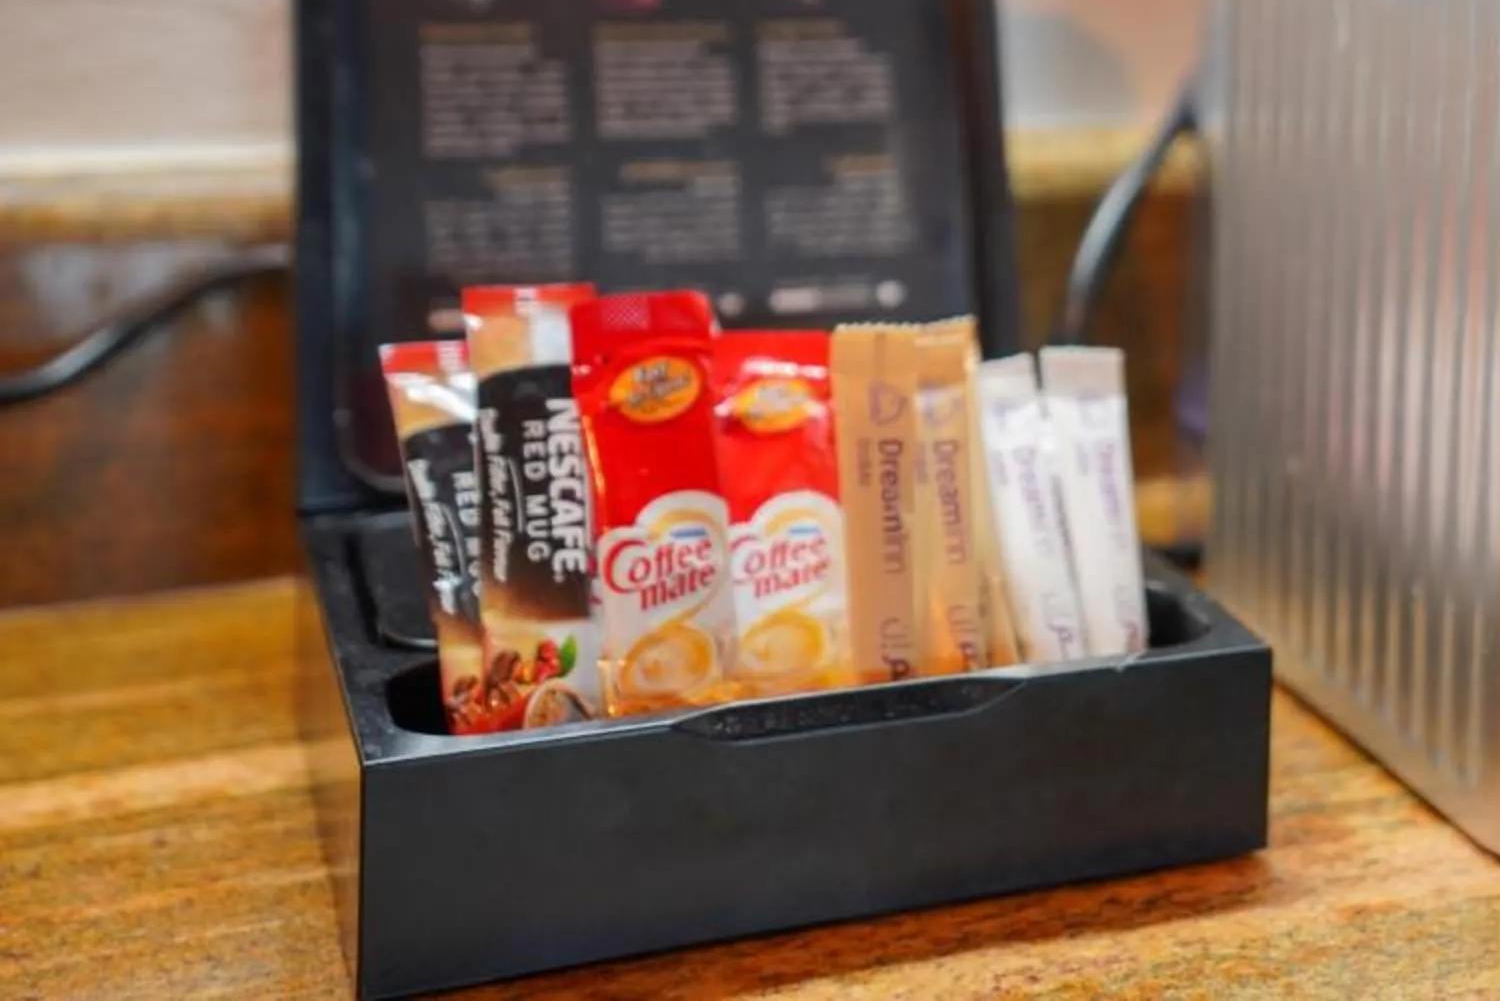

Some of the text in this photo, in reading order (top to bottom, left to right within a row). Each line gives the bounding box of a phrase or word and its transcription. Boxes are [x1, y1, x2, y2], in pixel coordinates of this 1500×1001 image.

[522, 419, 551, 562] RED MUG
[603, 539, 711, 594] Coffee
[640, 564, 716, 610] mate
[754, 559, 830, 598] mate
